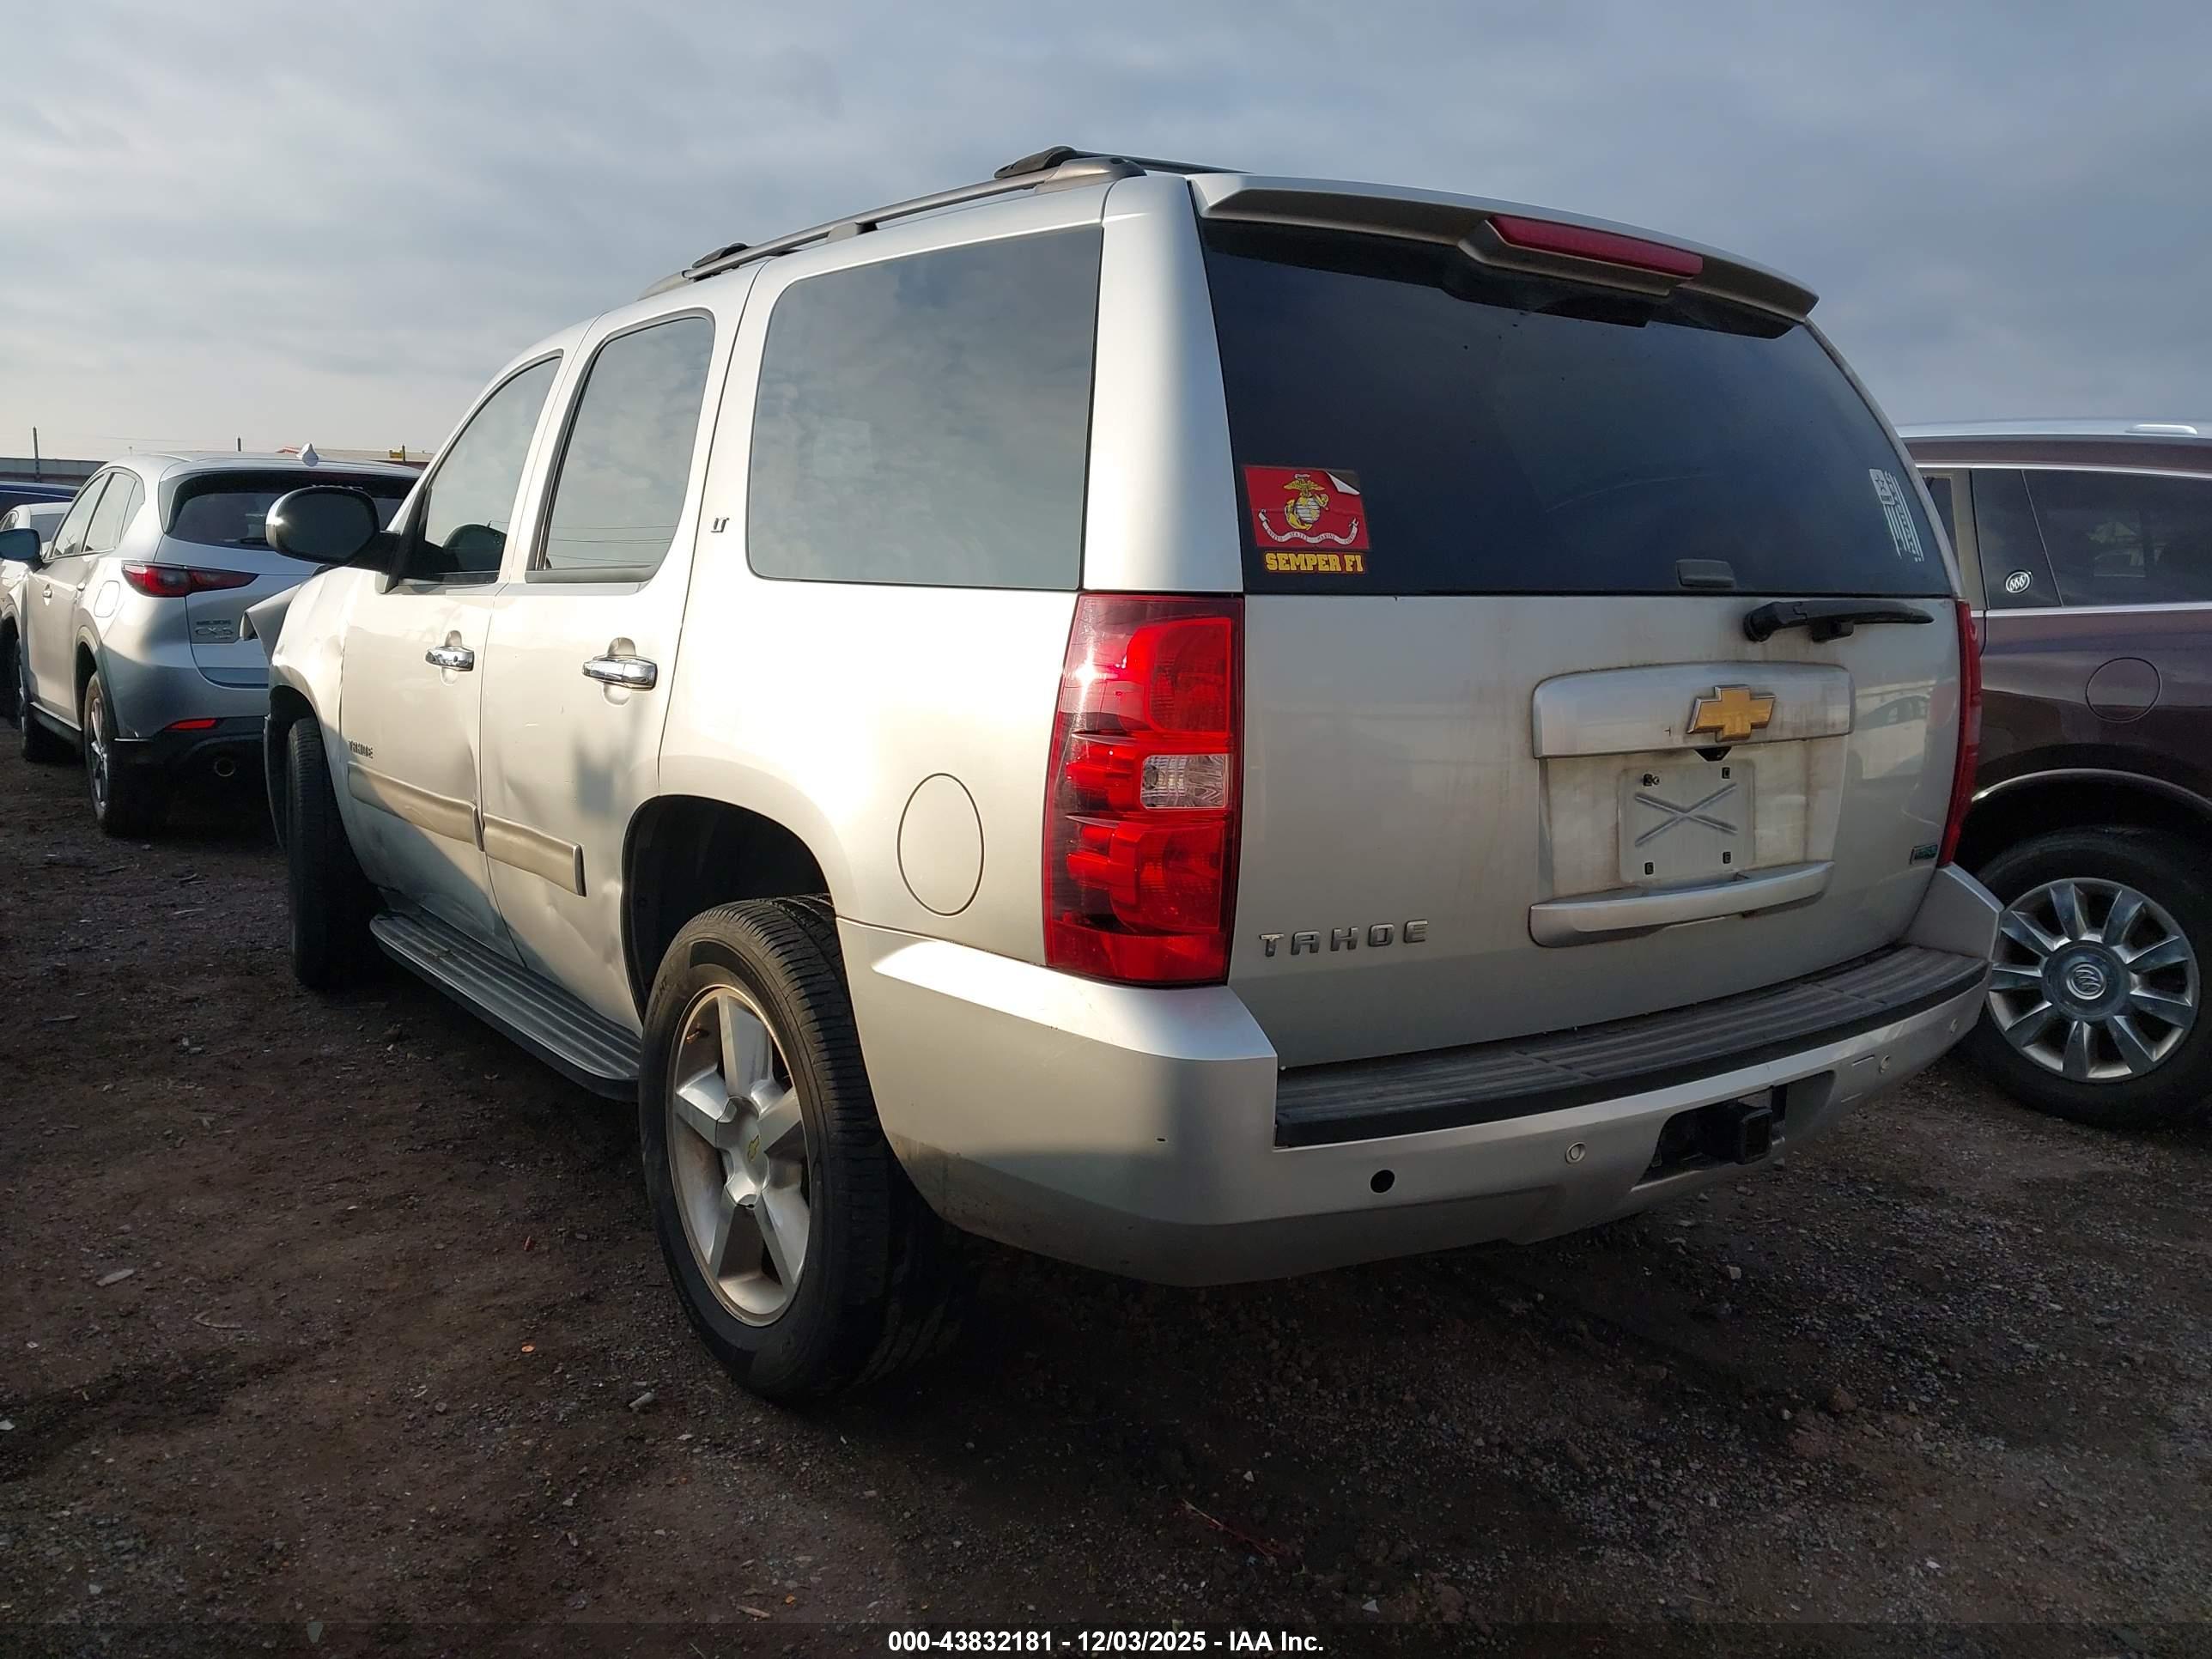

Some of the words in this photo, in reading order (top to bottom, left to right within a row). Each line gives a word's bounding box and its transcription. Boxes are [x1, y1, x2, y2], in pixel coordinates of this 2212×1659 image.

[710, 517, 730, 533] LT
[1265, 552, 1342, 572] SEMPER
[1344, 554, 1364, 572] FI
[1259, 919, 1429, 957] TAHOE
